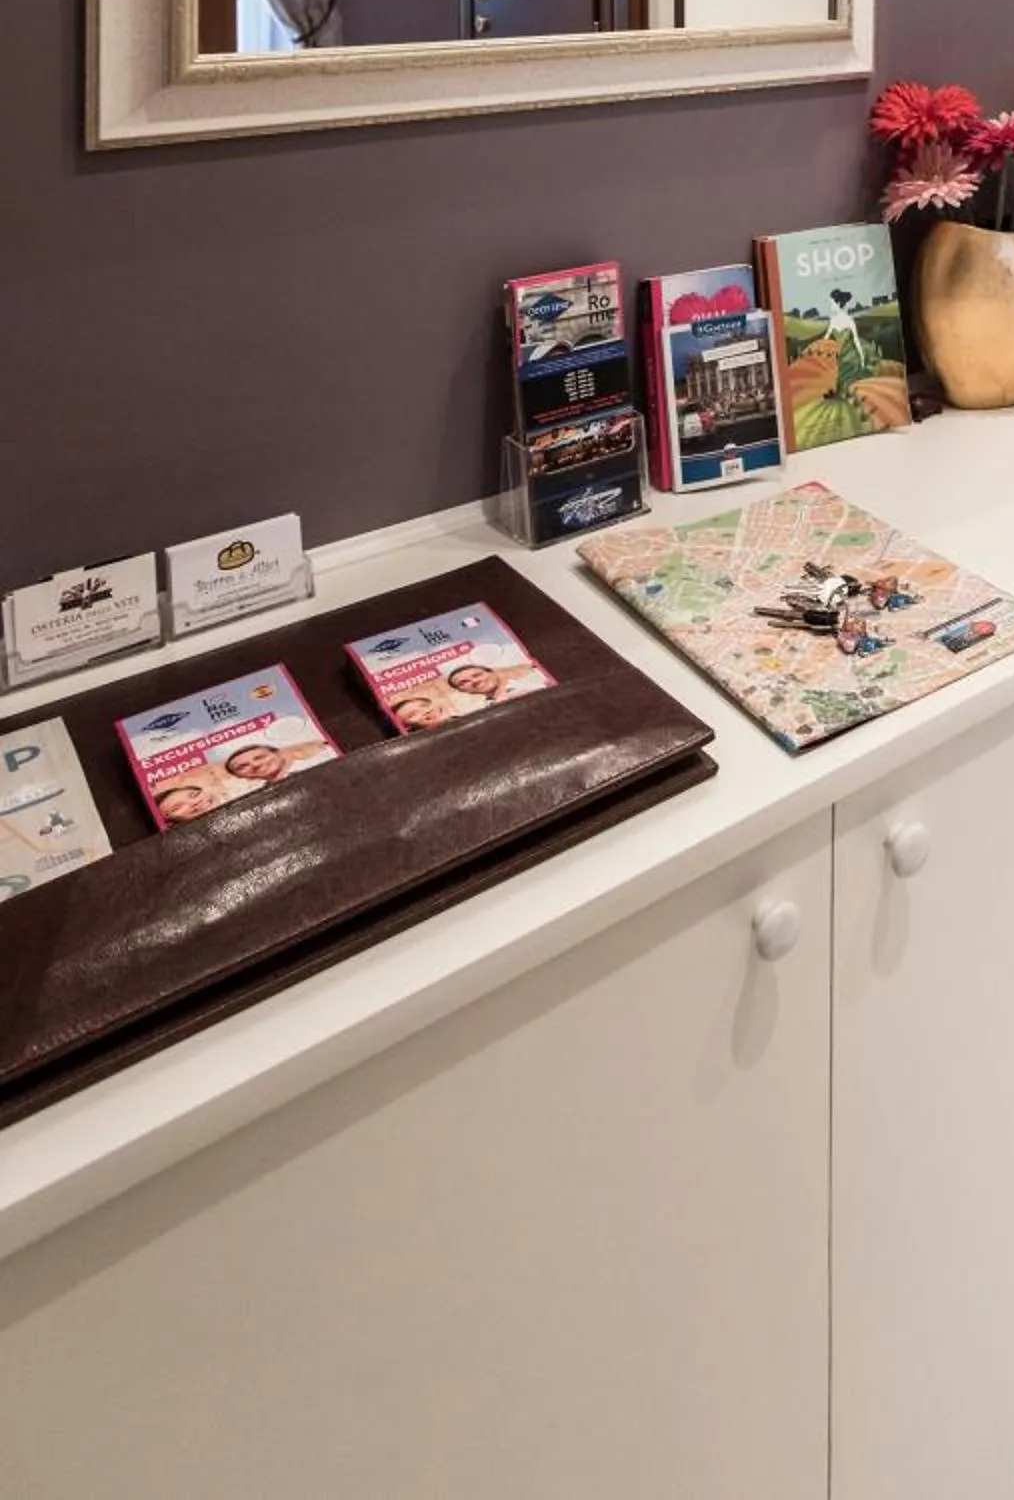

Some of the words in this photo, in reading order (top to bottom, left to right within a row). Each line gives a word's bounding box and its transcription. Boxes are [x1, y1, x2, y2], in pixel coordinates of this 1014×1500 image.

[795, 242, 876, 278] SHOP
[31, 613, 82, 635] OSTERIA
[374, 649, 457, 682] Escursioni
[380, 670, 438, 695] Mappa
[141, 720, 257, 769] Excursiones
[262, 714, 273, 728] y
[4, 746, 41, 773] P
[146, 757, 202, 784] Mapa
